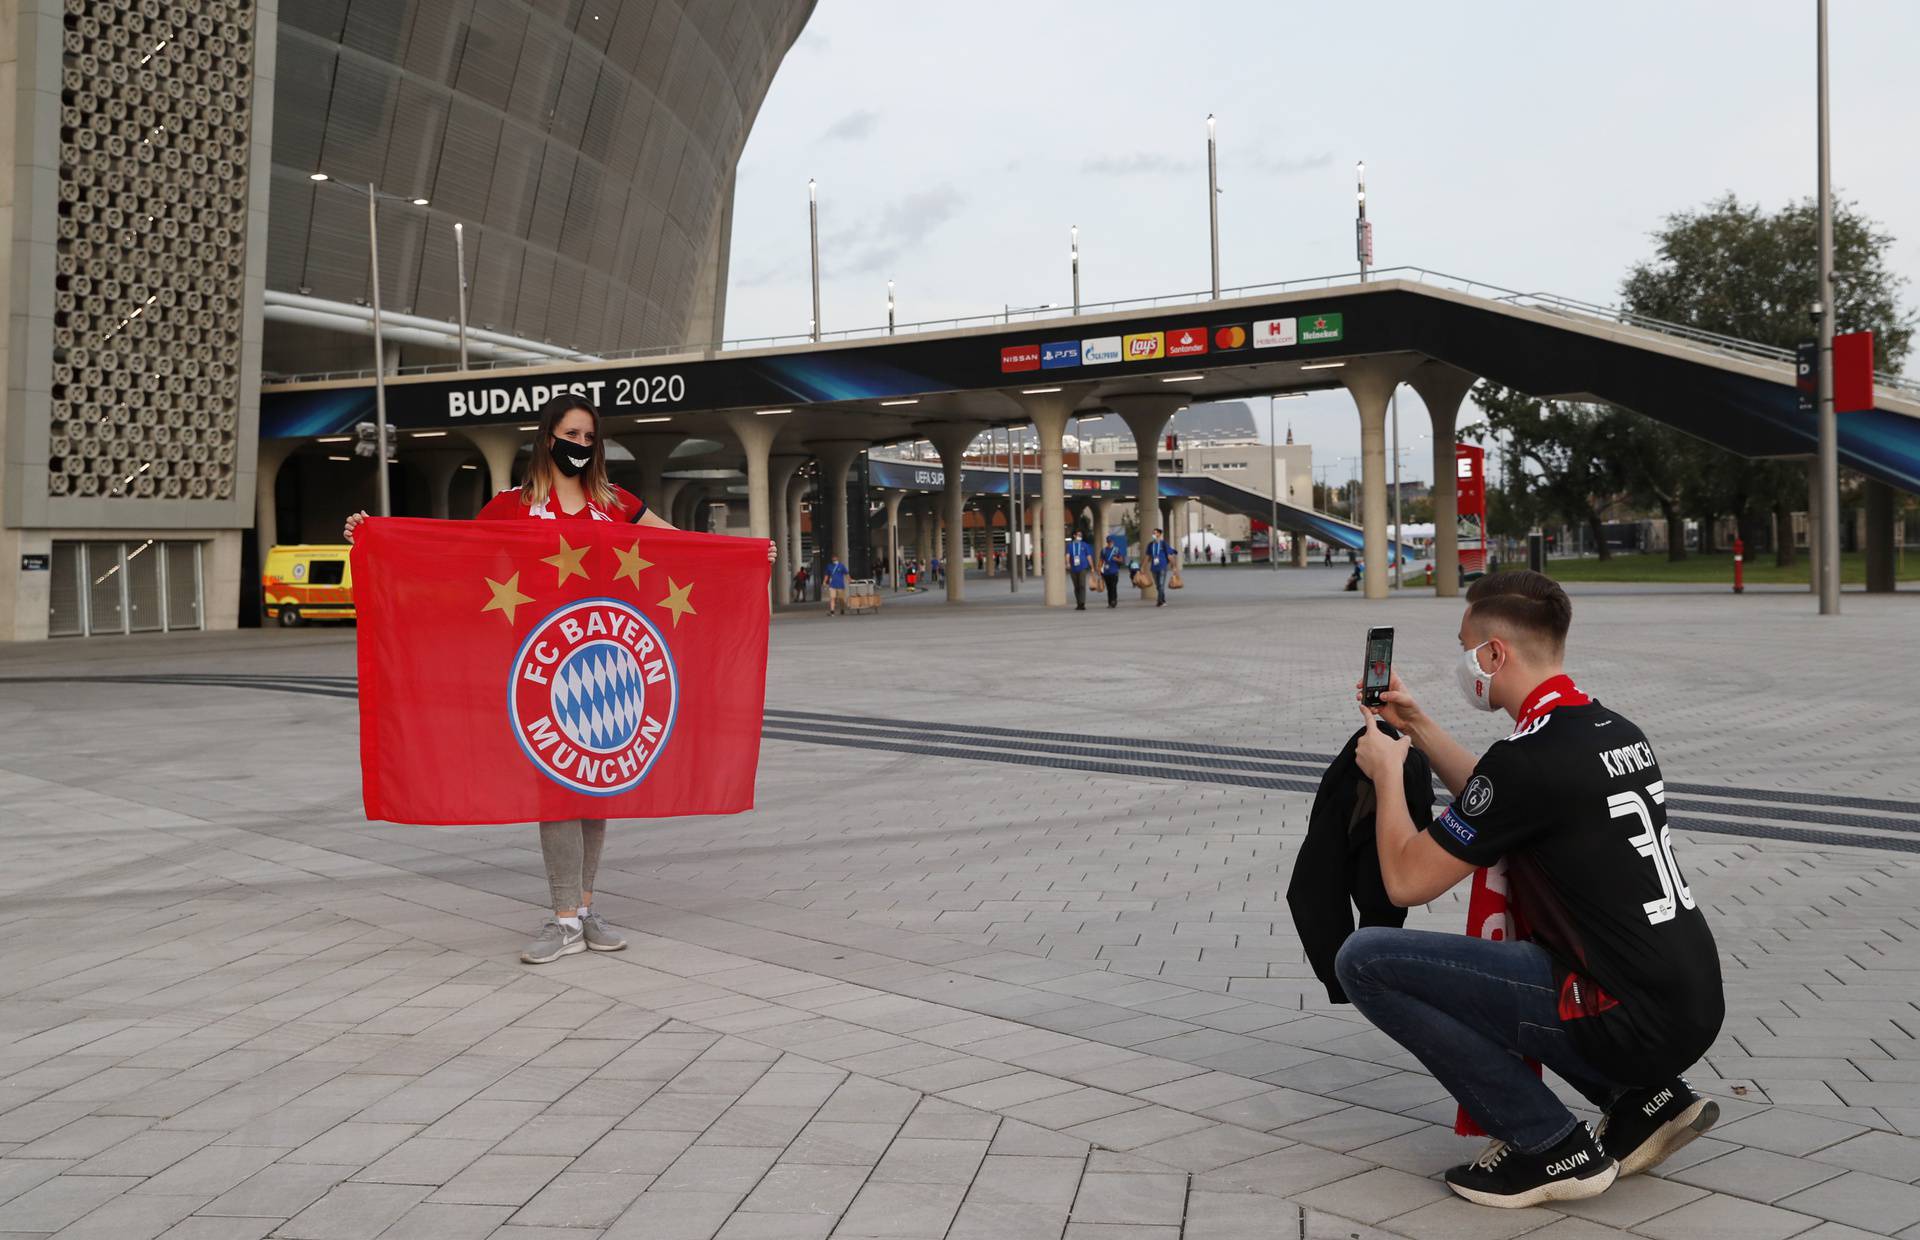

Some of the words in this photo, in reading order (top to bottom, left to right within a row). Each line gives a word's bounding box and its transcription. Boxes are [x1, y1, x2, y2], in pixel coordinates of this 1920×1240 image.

[1302, 330, 1338, 340] Heineken
[1002, 353, 1039, 364] NISSAN
[1054, 349, 1078, 359] PS5
[1170, 344, 1203, 354] Santander
[448, 380, 606, 418] BUDAPEST
[615, 374, 686, 406] 2020
[914, 470, 930, 484] UEFA
[523, 640, 560, 685] FC
[558, 611, 667, 685] BAYERN
[526, 715, 663, 784] MÜNCHEN
[1469, 794, 1477, 805] 6
[1444, 812, 1475, 841] RESPECT
[1642, 1088, 1675, 1117] KLEIN
[1545, 1149, 1591, 1176] CALVIN
